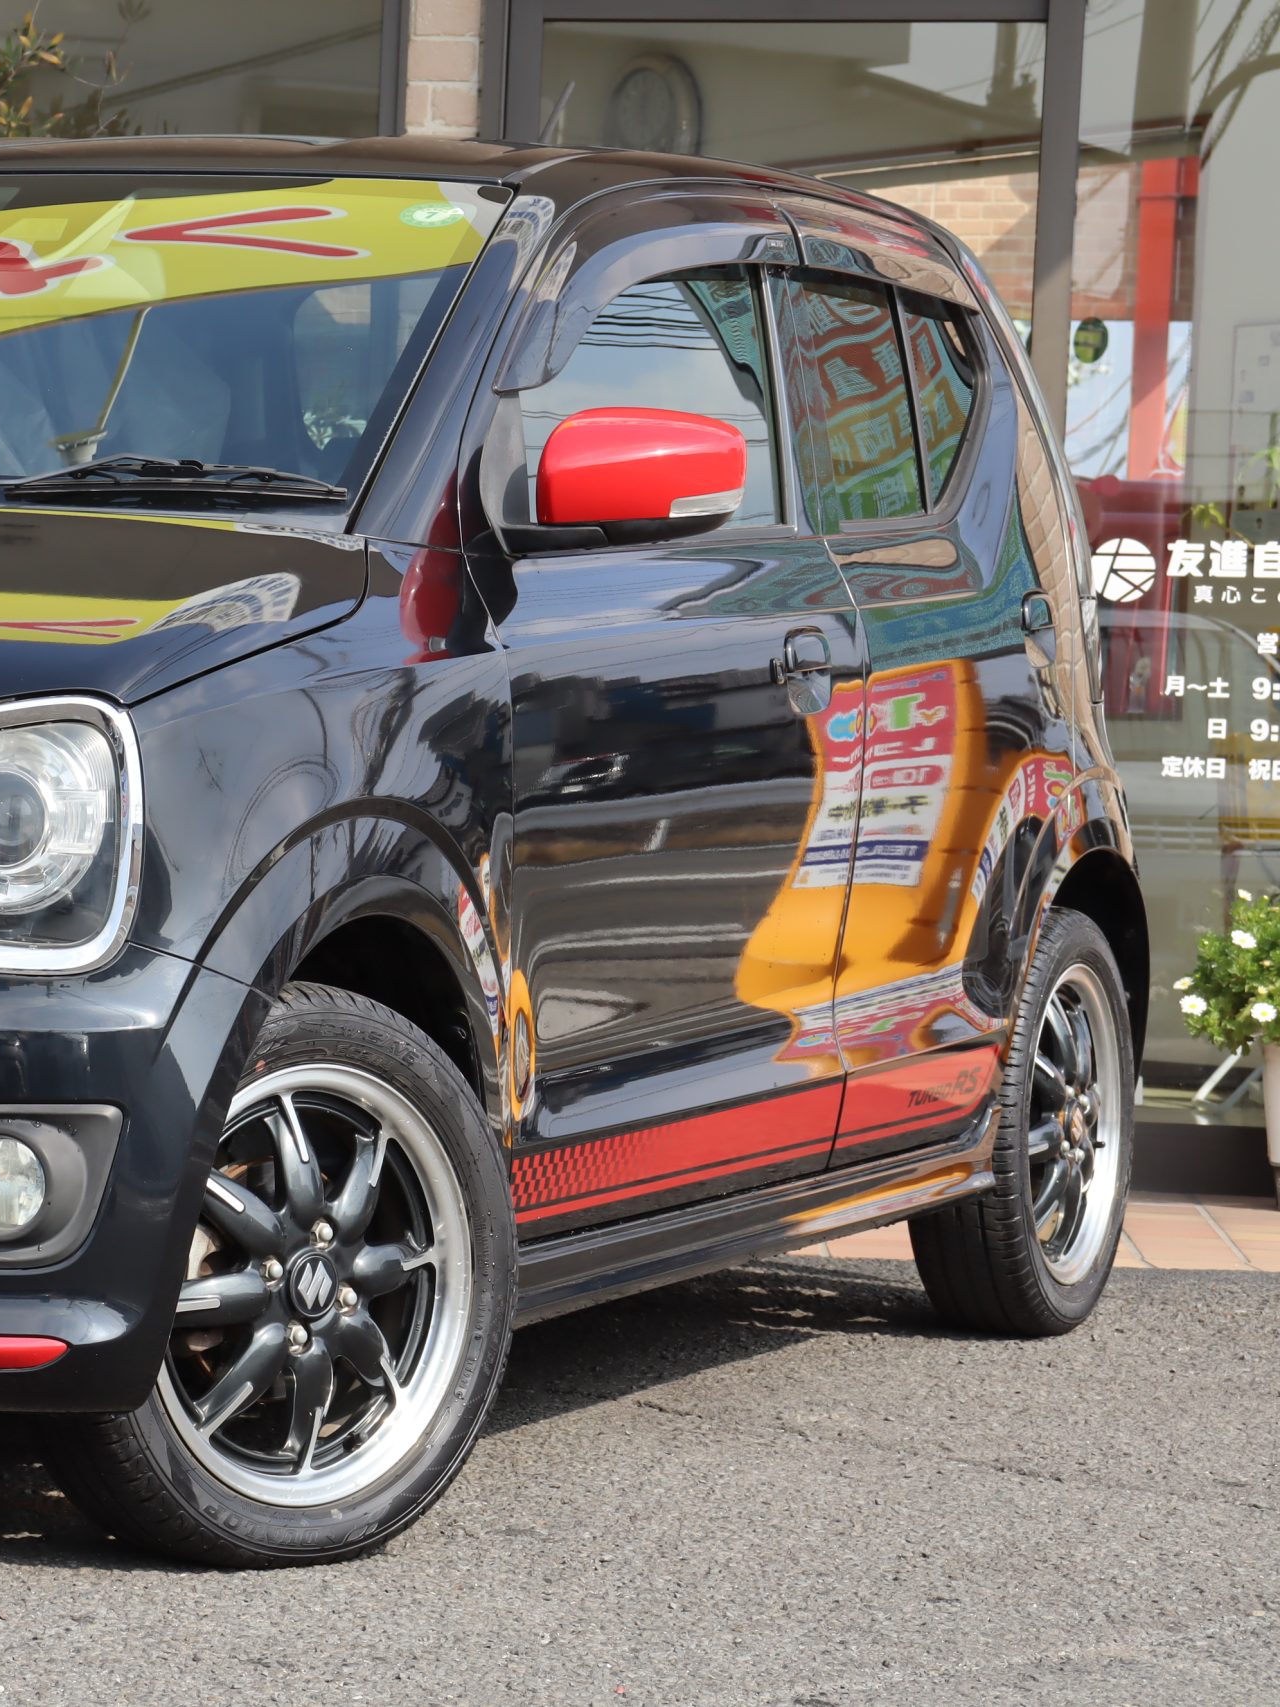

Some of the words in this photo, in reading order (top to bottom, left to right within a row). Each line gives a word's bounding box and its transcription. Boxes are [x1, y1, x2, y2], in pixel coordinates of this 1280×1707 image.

[1194, 585, 1280, 604] 真心こ
[1207, 718, 1227, 739] 日
[1161, 756, 1226, 779] 定休日
[952, 1064, 984, 1097] RS
